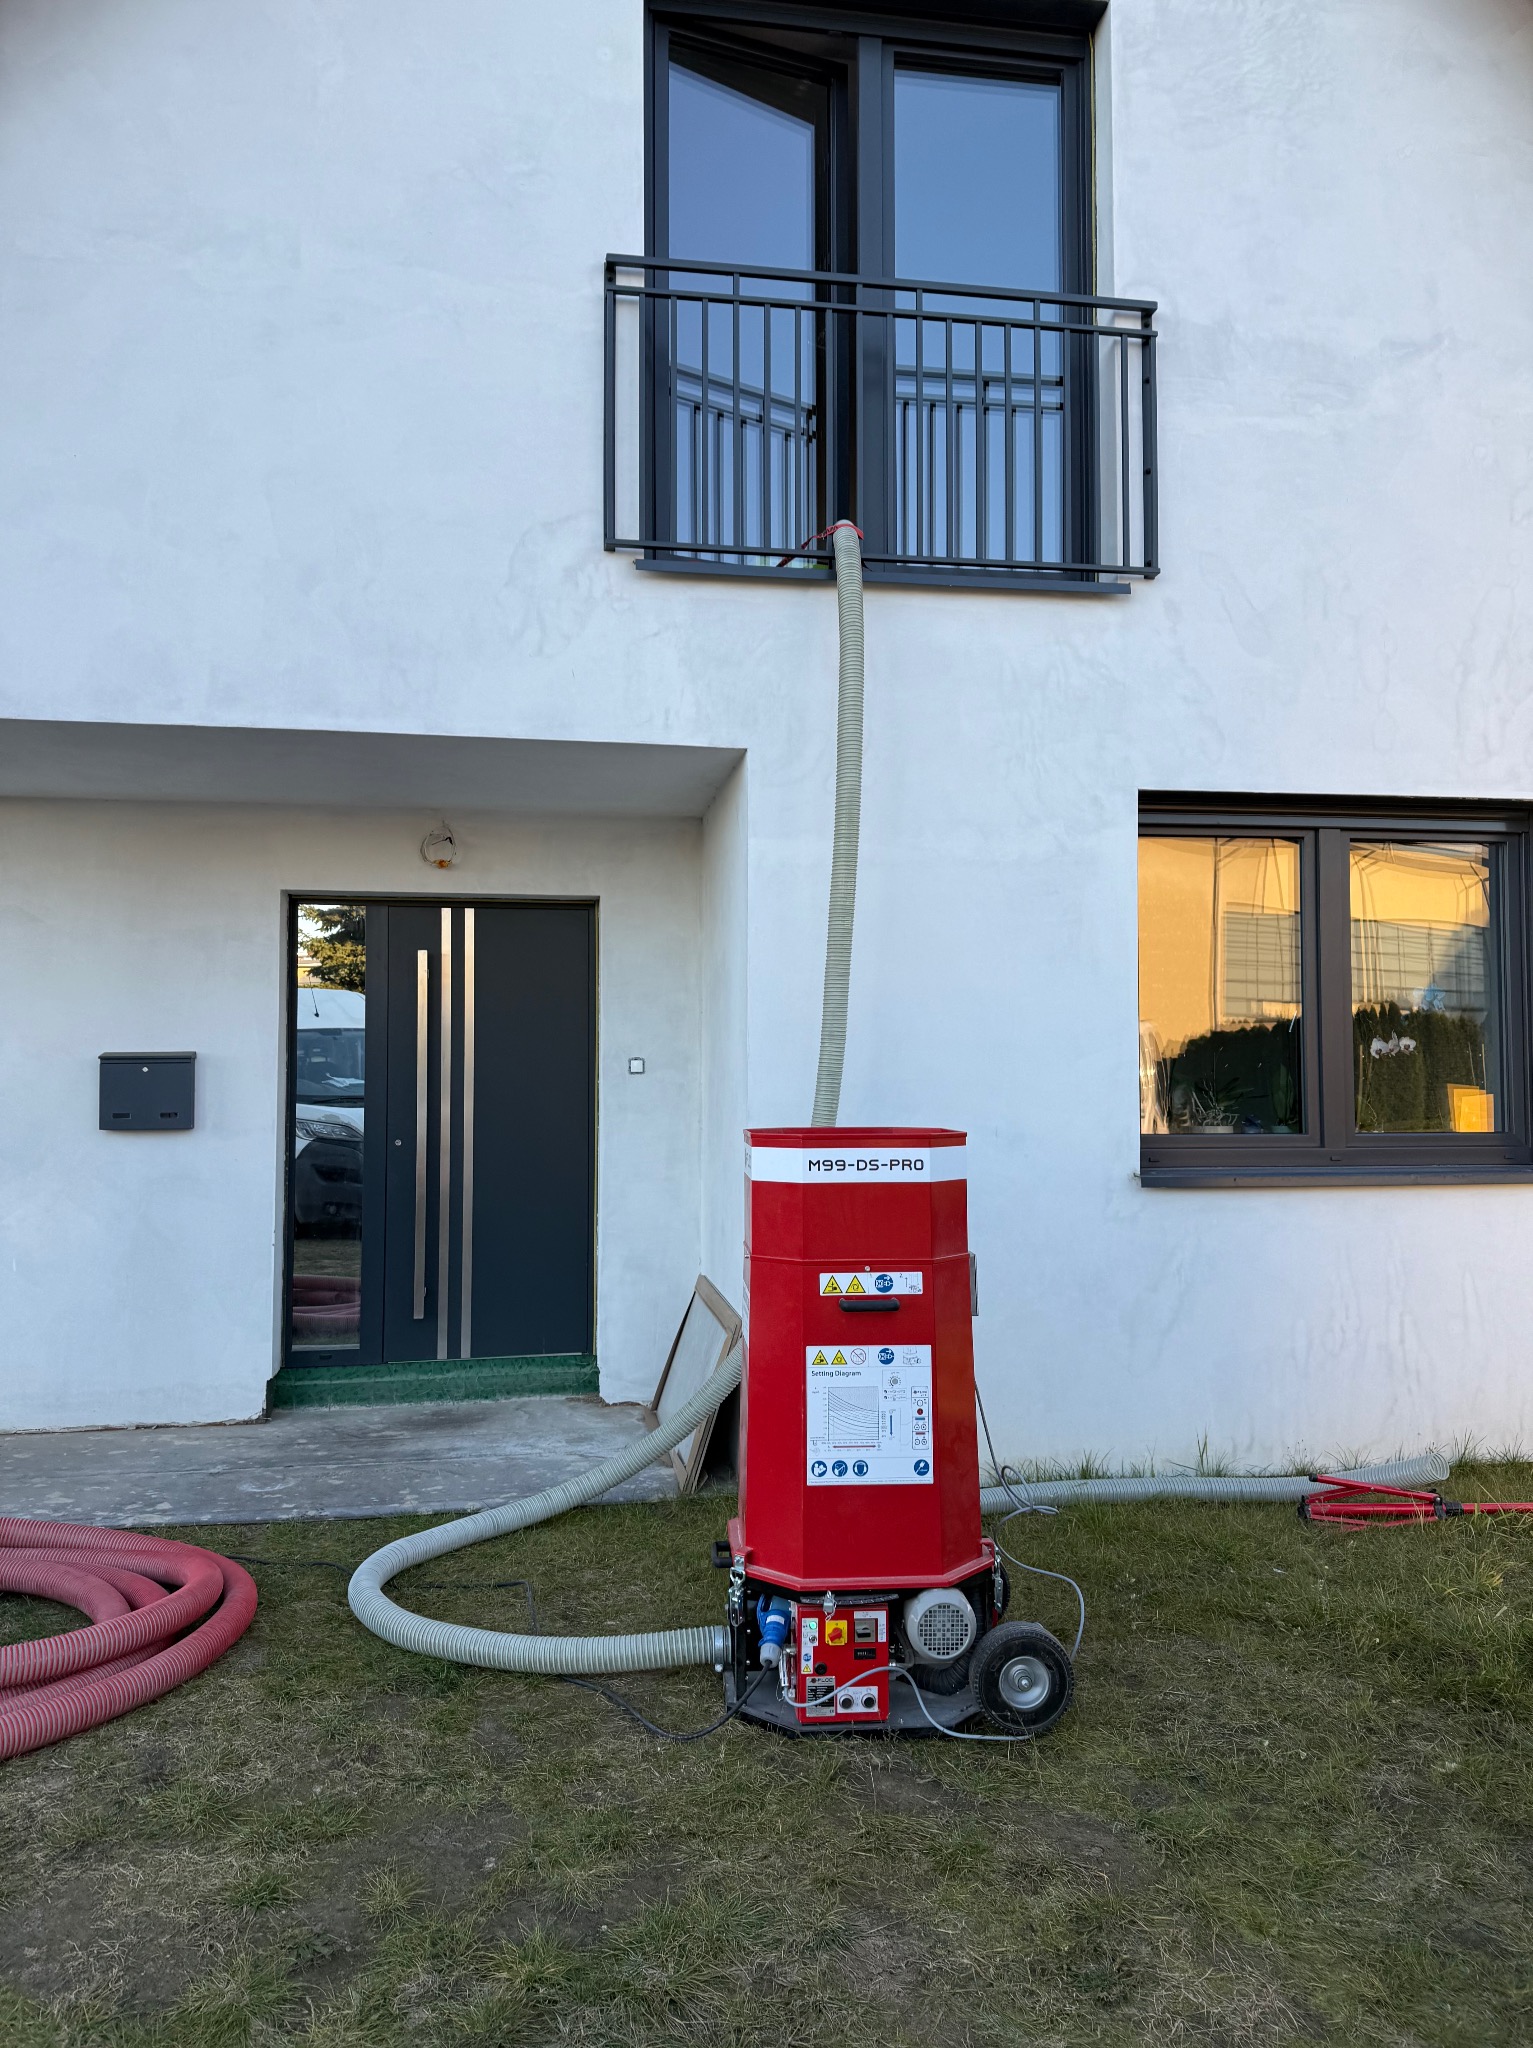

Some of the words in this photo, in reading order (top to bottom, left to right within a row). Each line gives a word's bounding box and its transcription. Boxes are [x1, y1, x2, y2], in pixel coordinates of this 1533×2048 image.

[808, 1158, 925, 1172] M99-DS-PRO
[811, 1370, 834, 1378] Setting
[834, 1370, 862, 1378] Diagram
